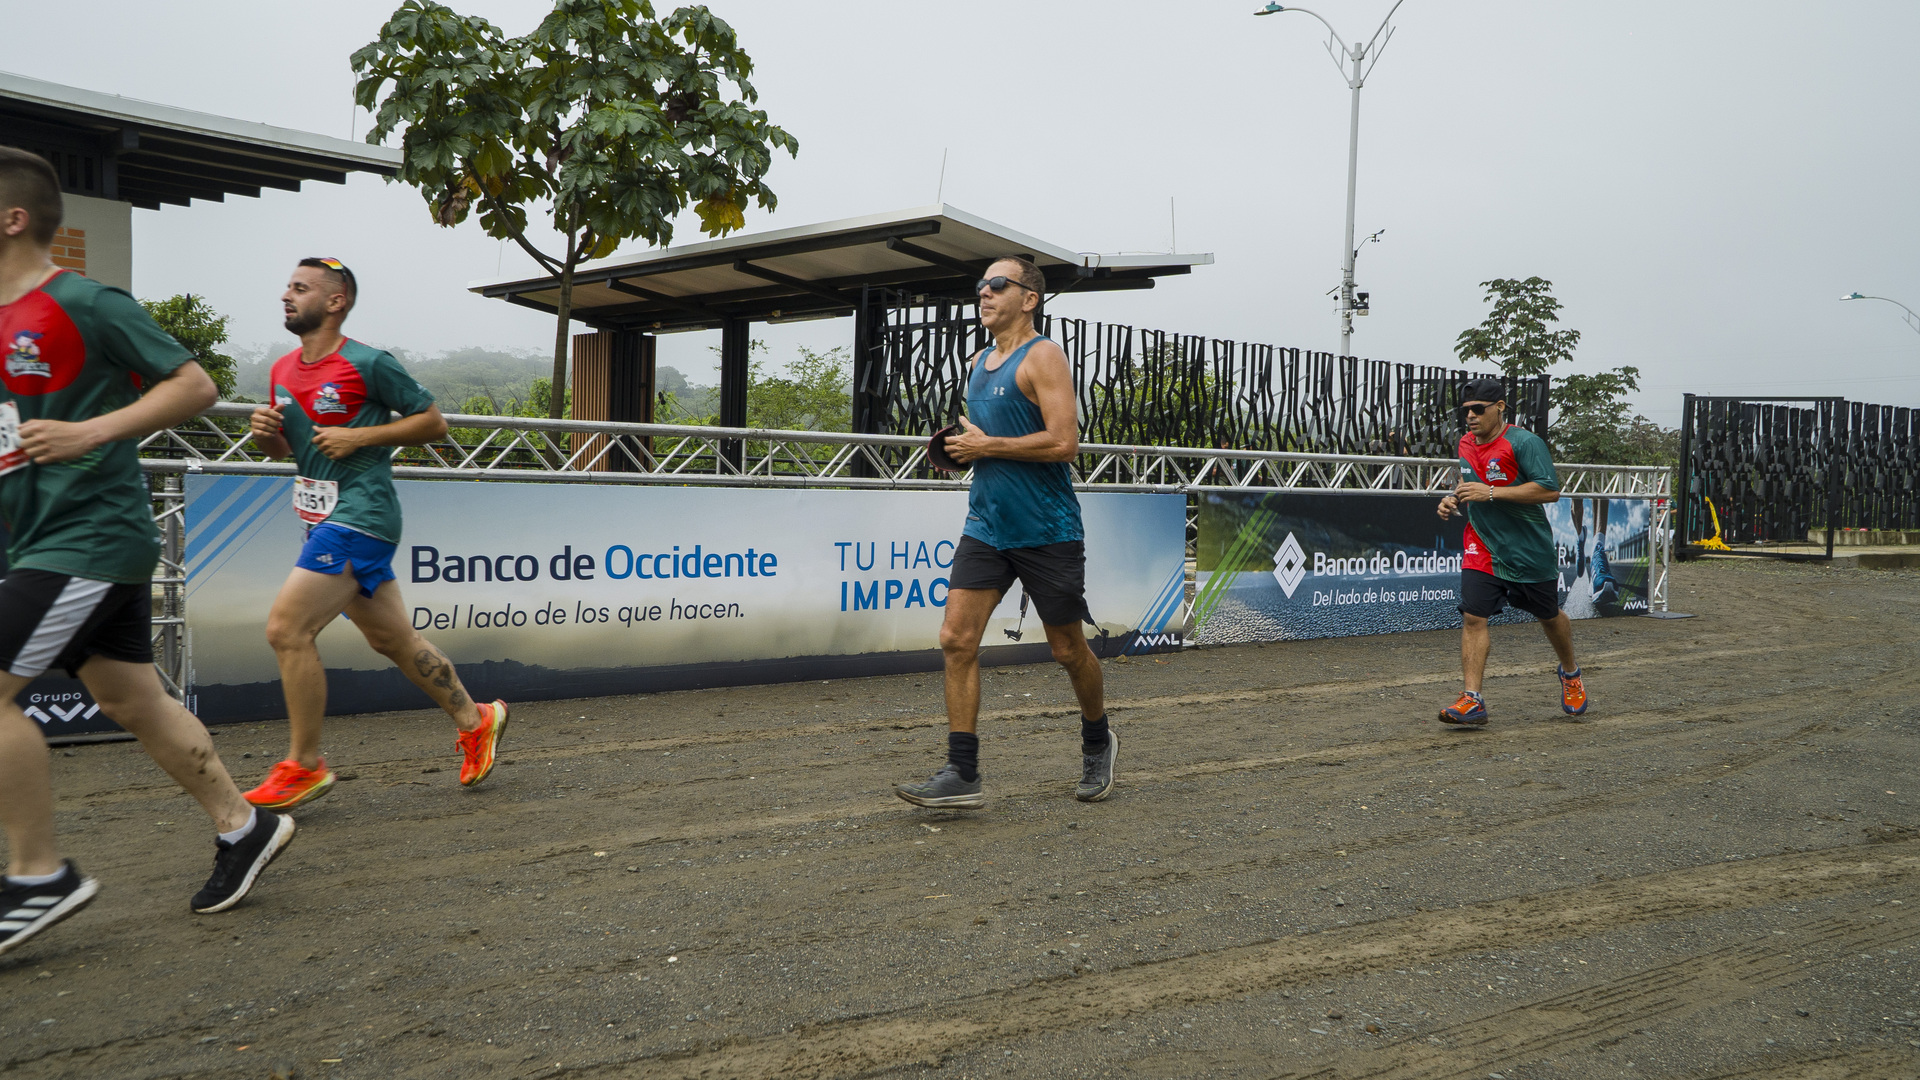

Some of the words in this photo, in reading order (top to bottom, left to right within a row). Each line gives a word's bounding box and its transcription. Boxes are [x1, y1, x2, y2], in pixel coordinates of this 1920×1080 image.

[411, 545, 539, 583] Banco
[549, 545, 596, 581] de
[604, 544, 778, 580] Occidente
[834, 541, 876, 571] TU
[890, 540, 956, 570] HAC
[1313, 552, 1367, 577] Banco
[1370, 551, 1391, 575] de
[1393, 550, 1463, 574] Occident
[1557, 546, 1571, 569] R,
[841, 577, 950, 612] IMPAC
[1313, 589, 1333, 607] Del
[1335, 588, 1359, 605] lado
[1362, 587, 1378, 604] de
[1380, 587, 1396, 603] los
[1398, 589, 1418, 605] que
[1421, 585, 1456, 601] hacen.
[1623, 600, 1648, 611] AVAL
[412, 604, 459, 631] Del
[467, 603, 528, 629] lado
[534, 601, 567, 626] de
[575, 601, 610, 624] los
[618, 603, 662, 628] que
[669, 598, 745, 620] hacen.
[1134, 633, 1180, 648] AVAL
[30, 692, 82, 703] Grupo
